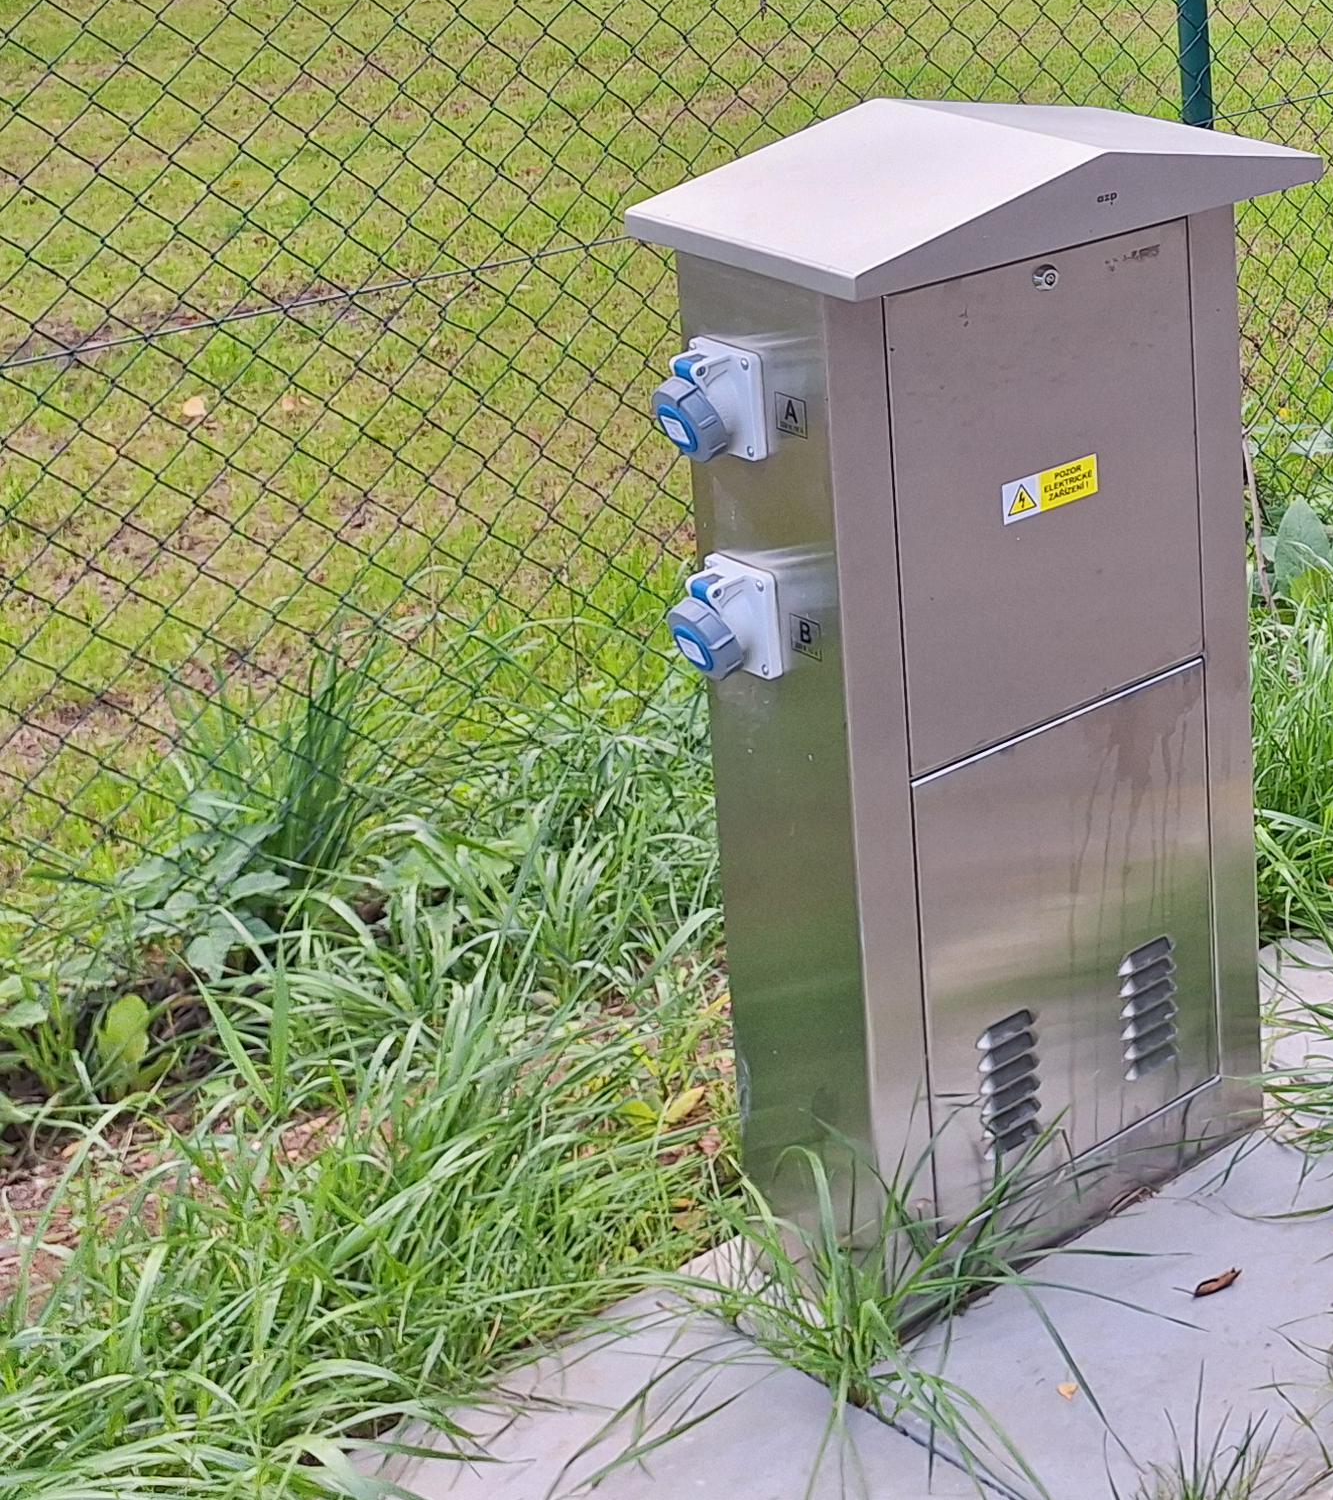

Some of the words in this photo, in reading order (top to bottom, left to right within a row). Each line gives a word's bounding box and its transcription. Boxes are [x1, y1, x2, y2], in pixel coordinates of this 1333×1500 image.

[785, 399, 798, 424] A
[1044, 469, 1093, 493] ELEKTRICKÉ
[1054, 465, 1081, 480] POZOR
[800, 620, 811, 645] B
